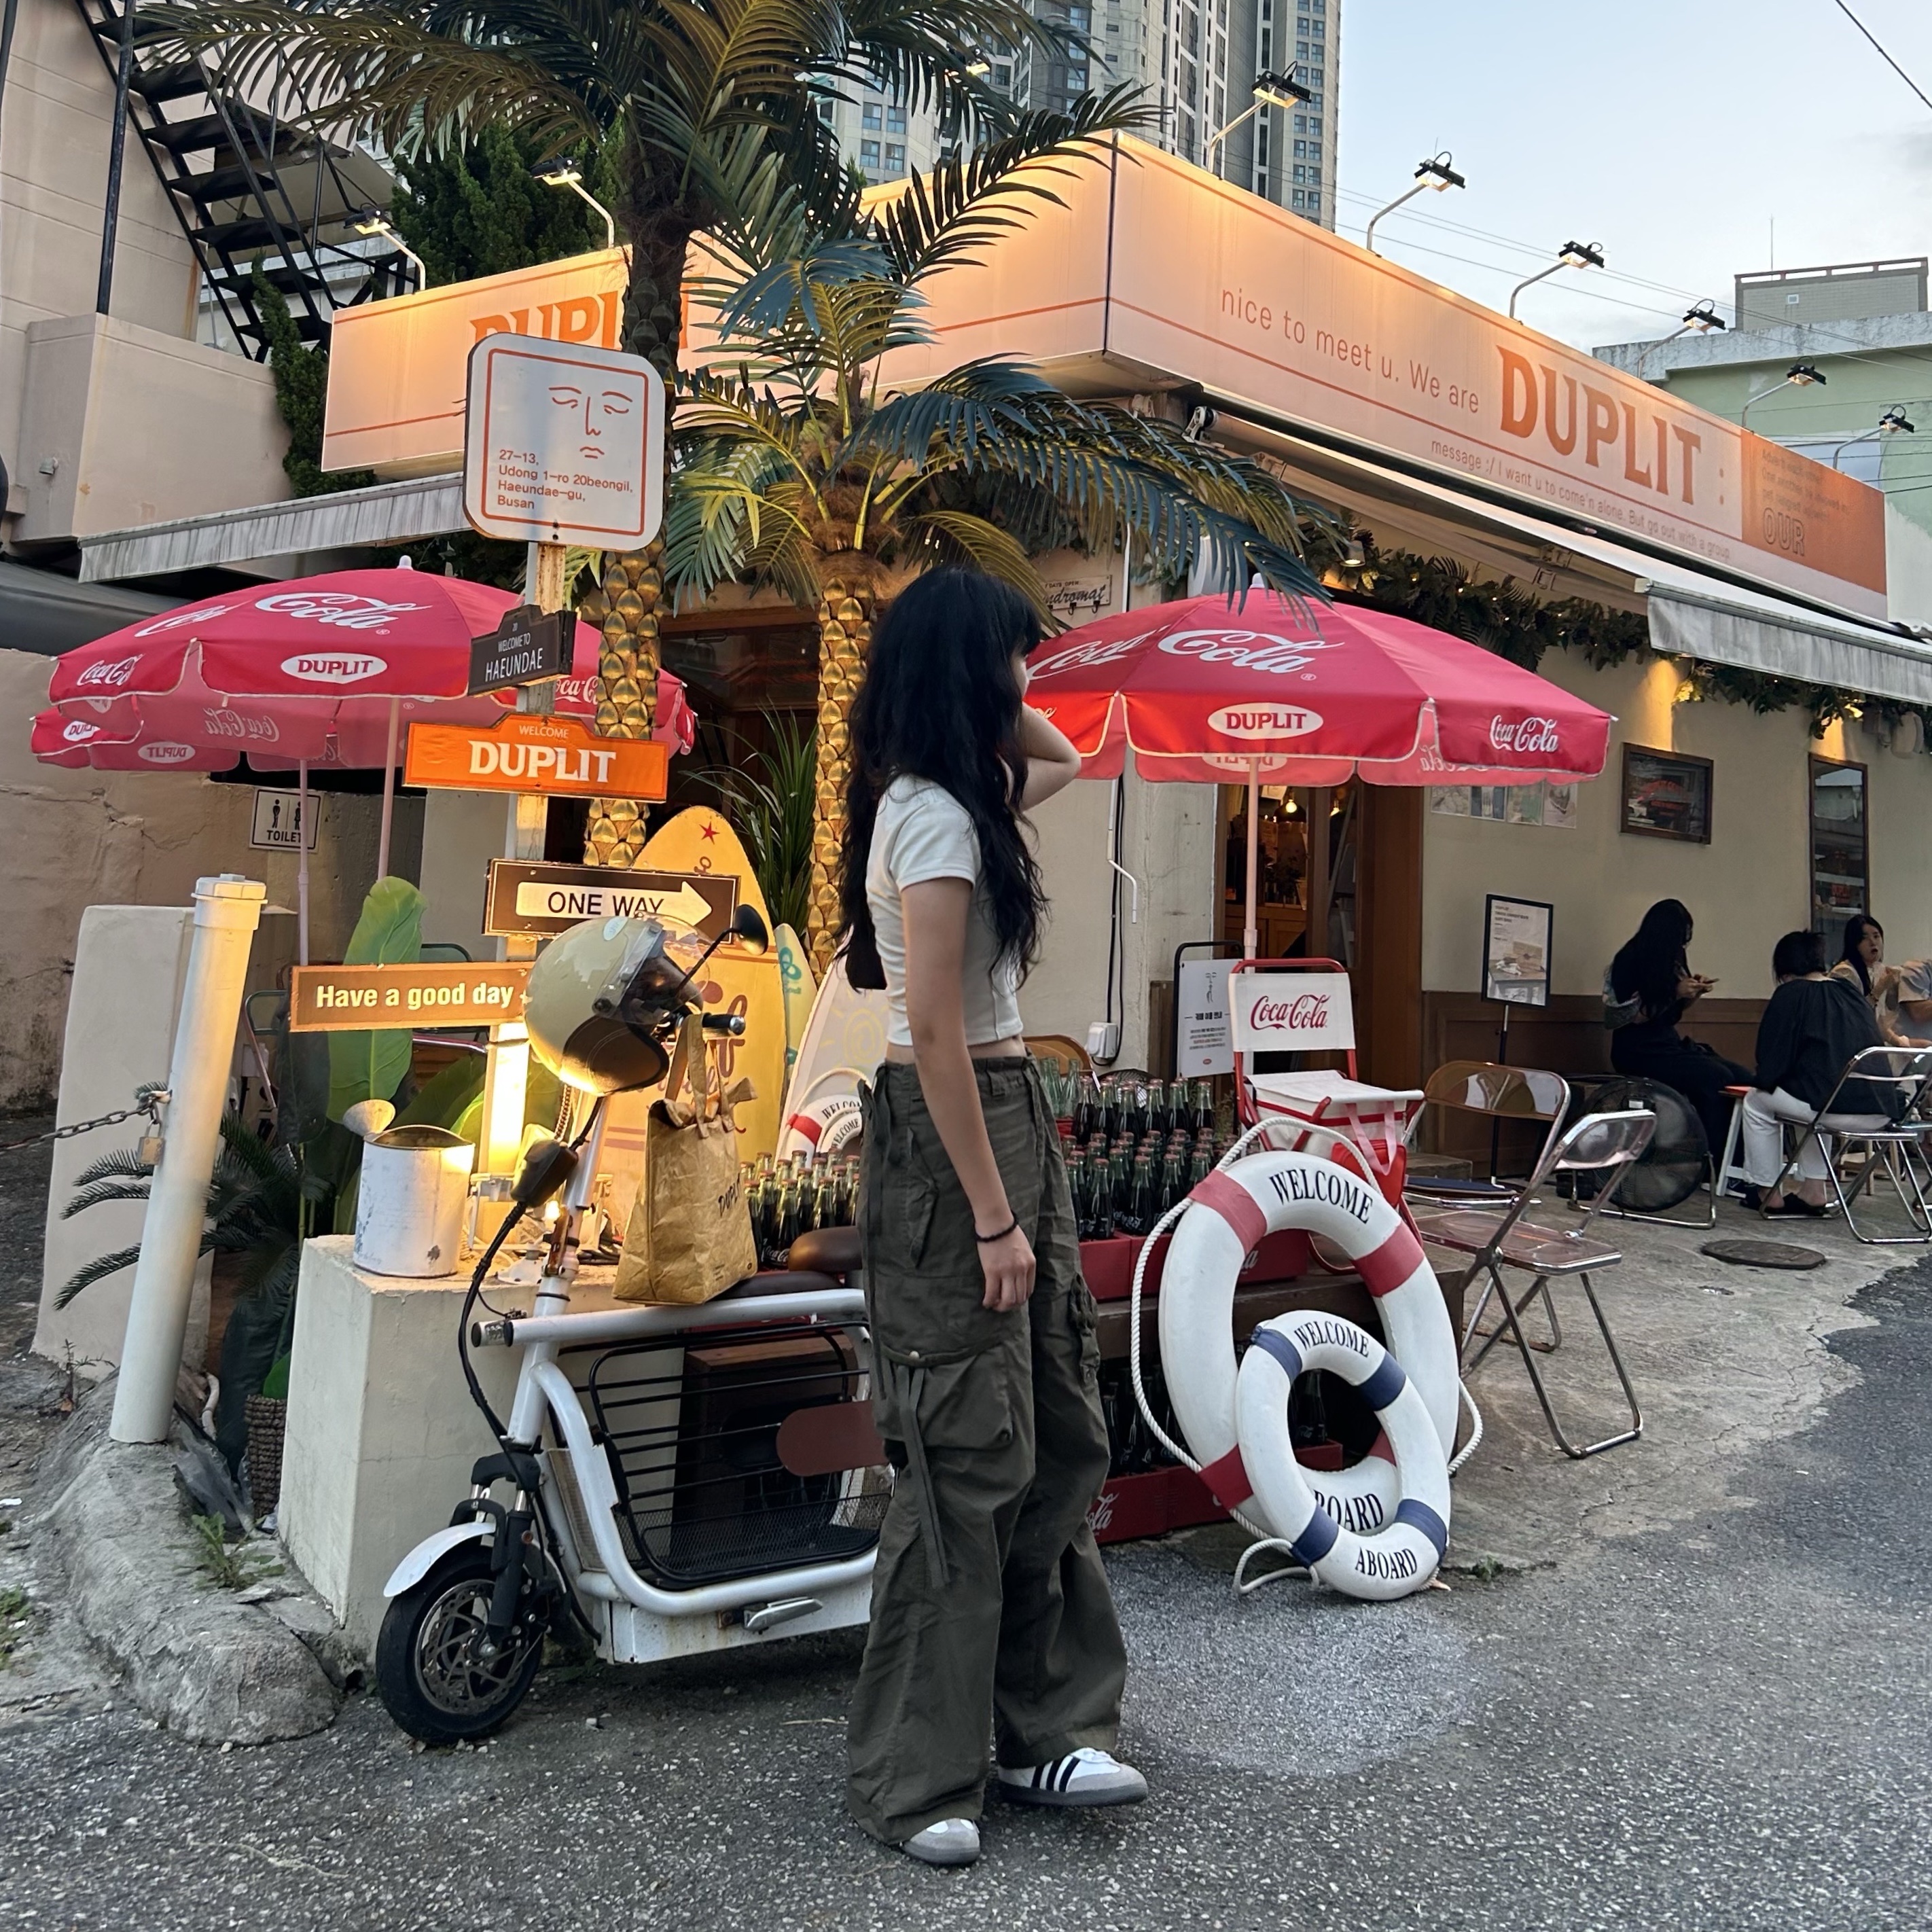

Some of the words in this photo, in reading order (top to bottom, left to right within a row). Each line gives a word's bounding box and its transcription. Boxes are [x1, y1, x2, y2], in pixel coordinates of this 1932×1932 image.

[1222, 288, 1272, 330] nice
[1283, 310, 1305, 344] to
[1317, 329, 1372, 372] meet
[1381, 357, 1399, 382] u.
[1410, 359, 1439, 398] We
[1448, 384, 1479, 414] are
[1496, 344, 1701, 505] DUPLIT
[499, 450, 539, 465] 27-13,
[498, 480, 586, 502] Haeundae-gu,
[499, 465, 538, 480] Udong
[543, 471, 569, 484] 1-ro
[573, 474, 633, 493] 20beongil,
[1431, 440, 1482, 470] message
[1505, 467, 1532, 488] want
[1535, 480, 1542, 490] u
[1545, 480, 1556, 495] to
[1629, 509, 1645, 529] But
[1647, 519, 1659, 536] go
[497, 495, 535, 509] Busan
[1763, 507, 1805, 556] OUR
[497, 634, 523, 652] WELCOME
[523, 632, 531, 646] TO
[297, 659, 374, 676] DUPLIT
[485, 647, 543, 682] HAEUNDAE
[519, 725, 570, 739] WELCOME
[1224, 712, 1308, 730] DUPLIT
[1490, 715, 1560, 752] Coca-Cola
[467, 740, 616, 783] DUPLIT
[548, 891, 603, 916] ONE
[612, 895, 664, 917] WAY
[316, 985, 378, 1008] Have
[384, 987, 399, 1007] a
[408, 982, 465, 1011] good
[473, 982, 514, 1009] day
[1250, 994, 1331, 1031] Coca-Cola
[1269, 1168, 1374, 1225] WELCOME
[1293, 1320, 1370, 1359] WELCOME
[1355, 1546, 1418, 1580] ABOARD
